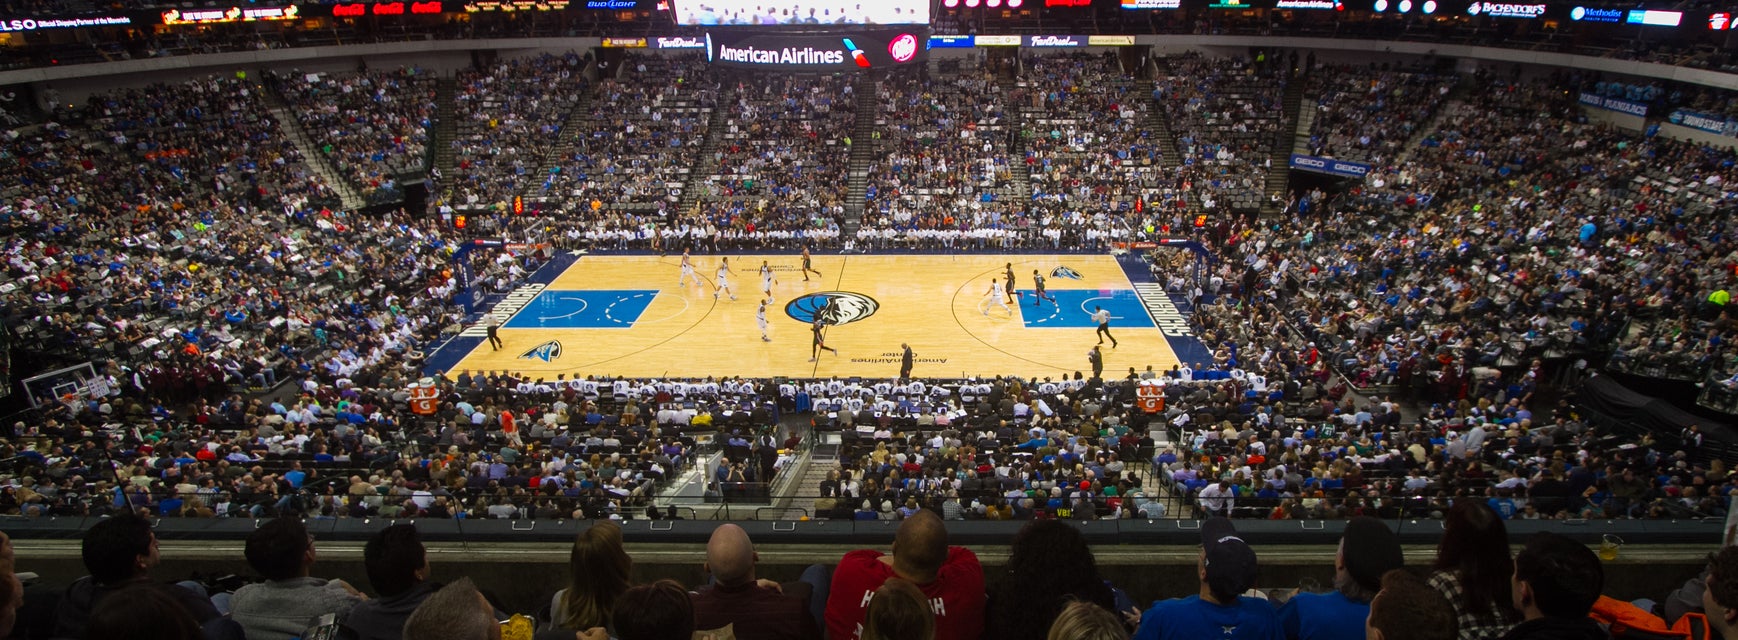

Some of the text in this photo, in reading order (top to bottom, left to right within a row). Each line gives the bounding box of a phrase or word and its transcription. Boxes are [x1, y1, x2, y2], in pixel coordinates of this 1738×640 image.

[1585, 8, 1622, 17] Methodist
[0, 19, 36, 31] LSO
[720, 44, 844, 64] American Airlines
[1295, 157, 1325, 168] GEICO
[1334, 163, 1366, 174] GEICO
[1133, 282, 1196, 337] MAVERICKS
[420, 400, 430, 410] G
[1145, 399, 1156, 408] G
